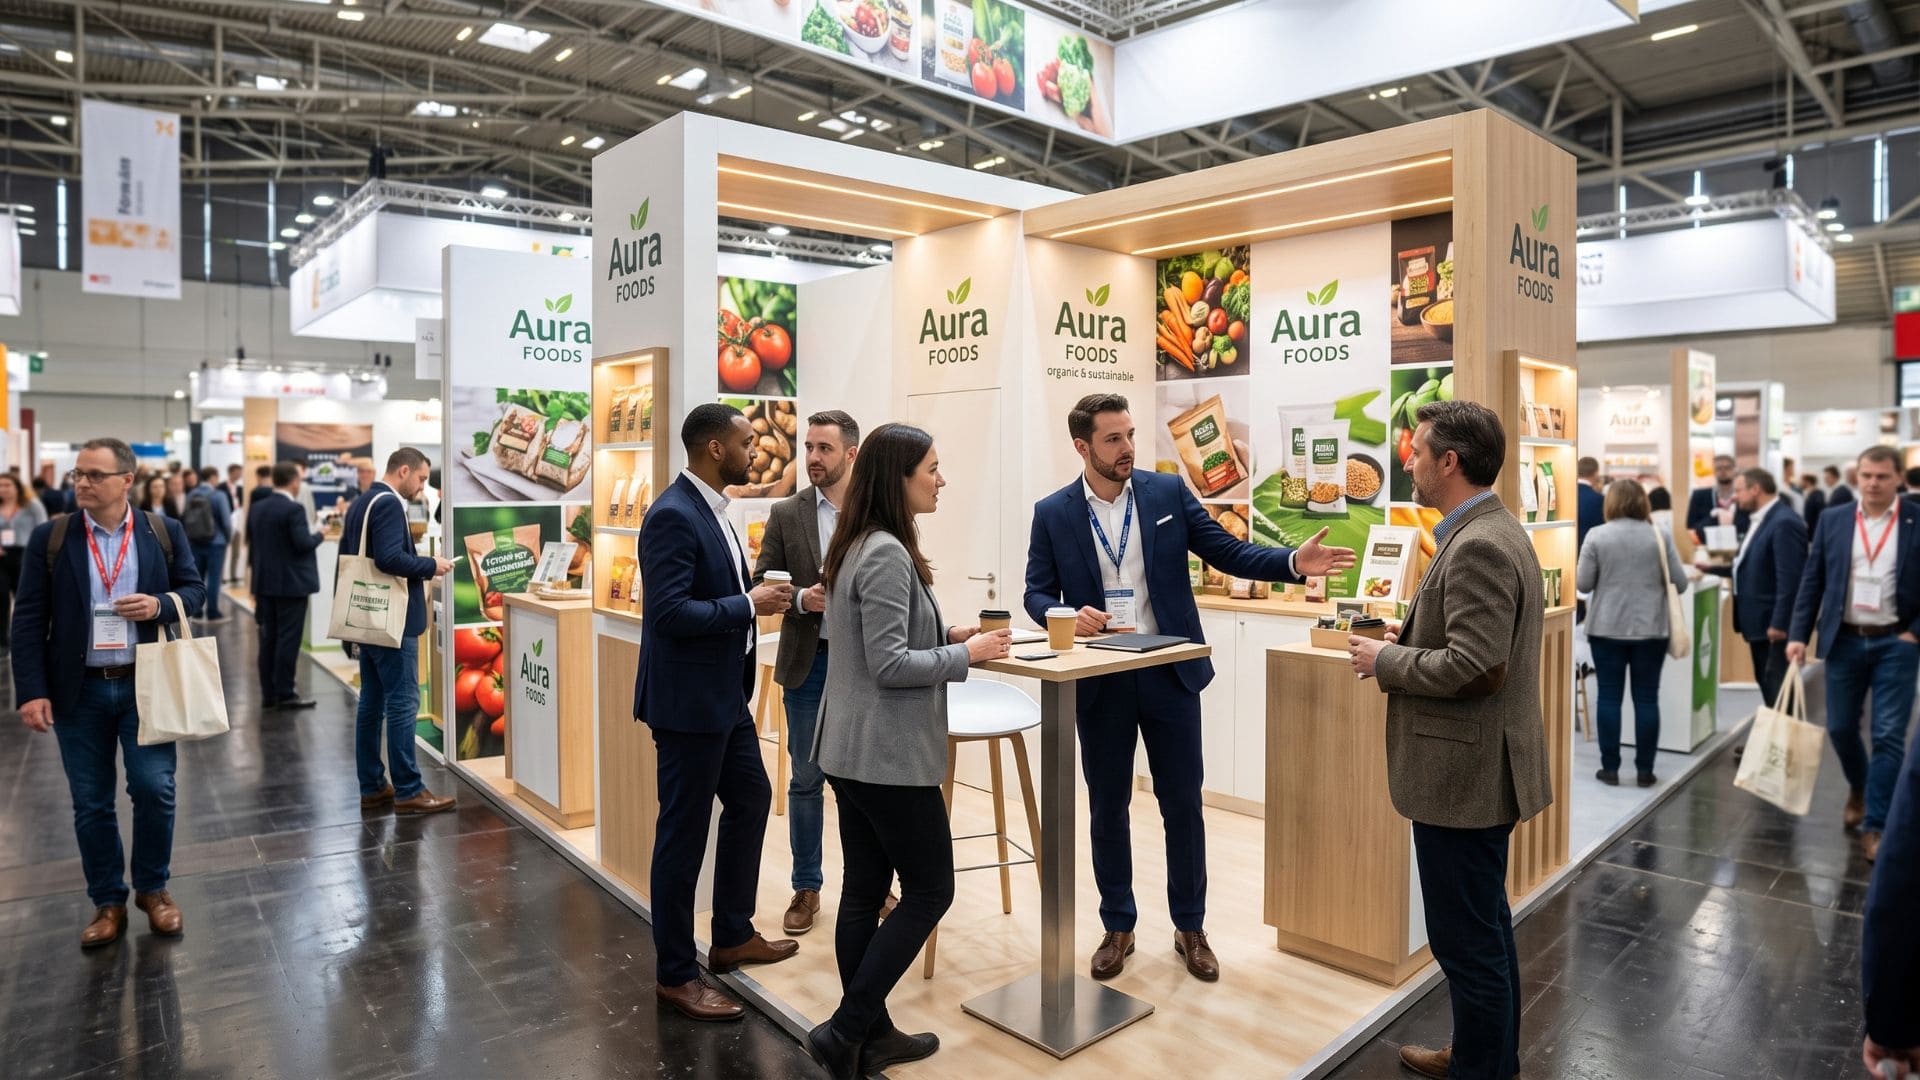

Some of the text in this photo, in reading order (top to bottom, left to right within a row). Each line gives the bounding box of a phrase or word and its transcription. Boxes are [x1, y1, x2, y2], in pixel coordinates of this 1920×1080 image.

[608, 232, 662, 281] Aura
[1509, 222, 1560, 280] Aura
[616, 275, 655, 303] FOODS
[1518, 275, 1554, 304] FOODS
[509, 309, 592, 344] Aura
[919, 308, 989, 344] Aura
[1054, 301, 1127, 343] Aura
[1270, 309, 1362, 343] Aura
[523, 346, 582, 363] FOODS
[929, 344, 979, 366] FOODS
[1066, 344, 1118, 364] FOODS
[1284, 344, 1350, 364] FOODS
[1047, 367, 1135, 382] organic & sustainable
[1609, 413, 1651, 427] Aura
[520, 652, 549, 690] Aura
[526, 686, 546, 706] FOODS
